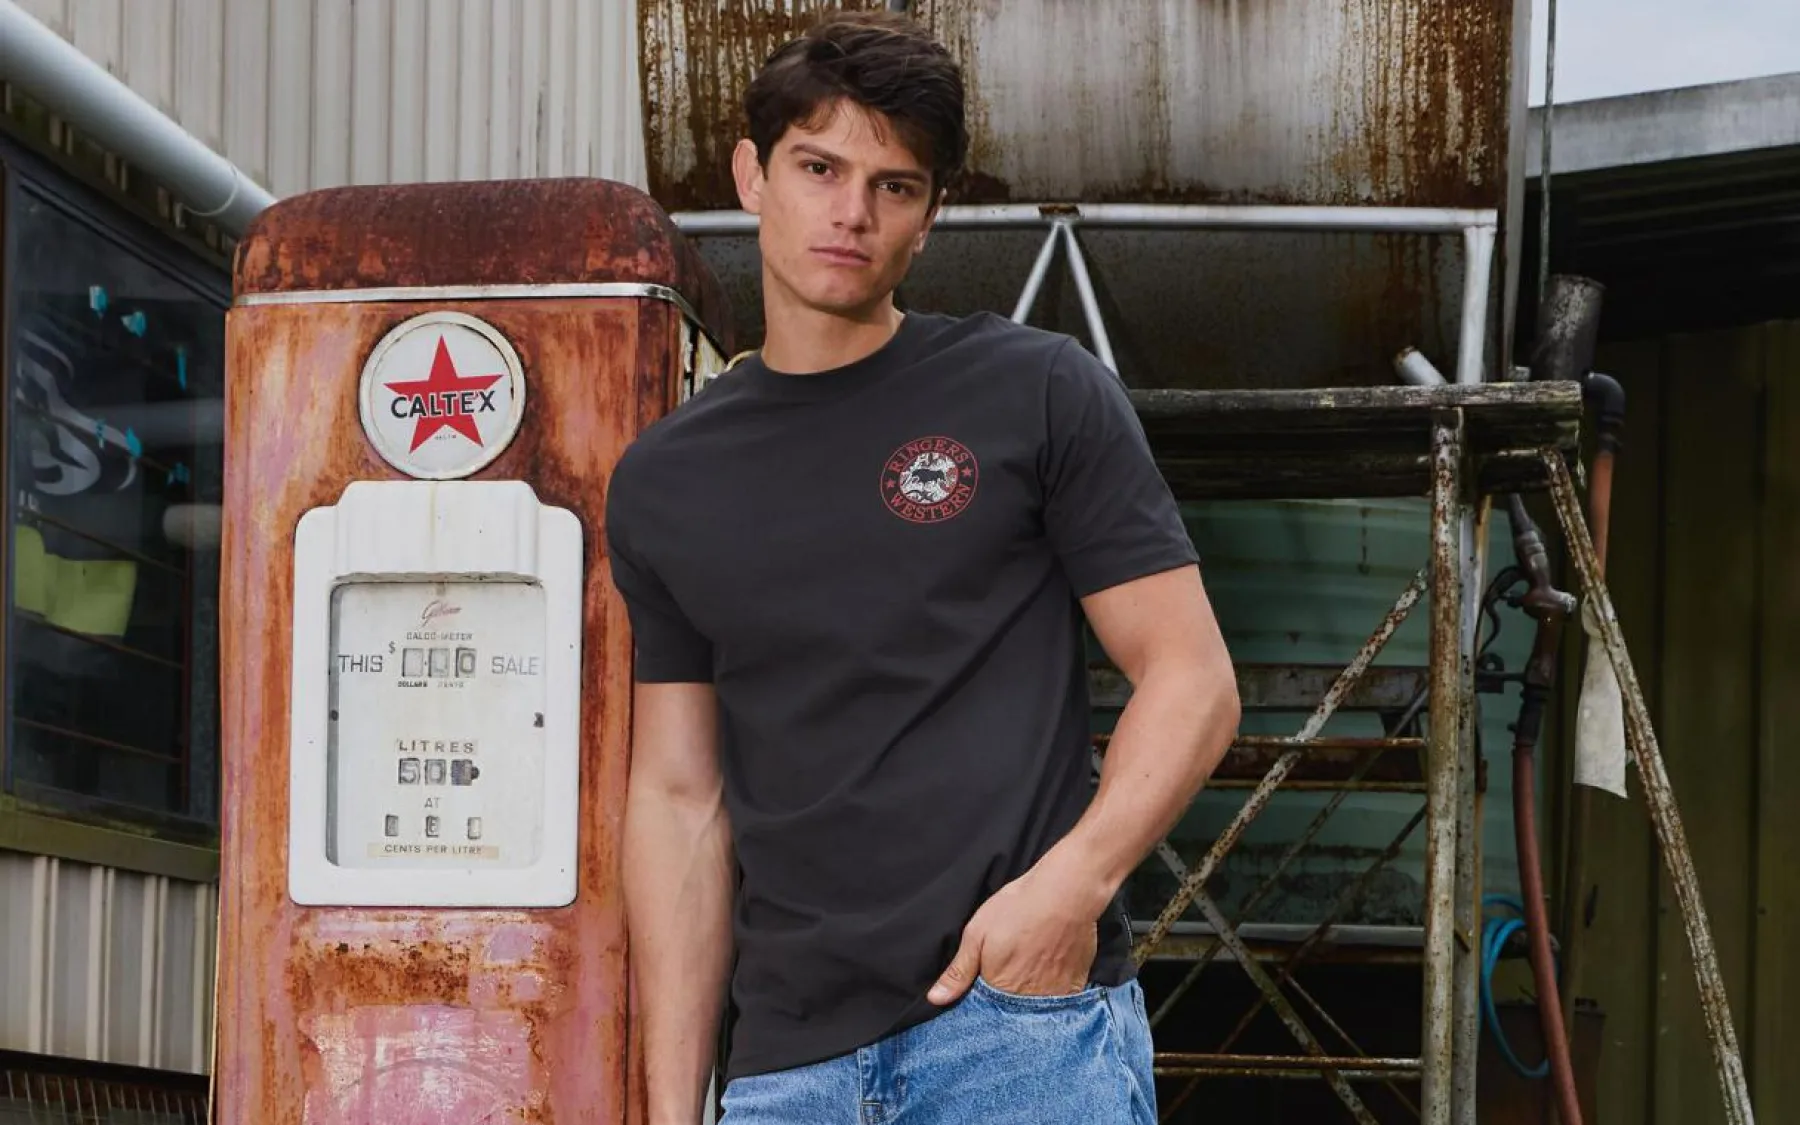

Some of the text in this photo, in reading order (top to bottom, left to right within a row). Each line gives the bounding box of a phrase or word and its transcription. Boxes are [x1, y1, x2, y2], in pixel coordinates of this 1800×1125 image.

[391, 390, 496, 418] CALTEX
[888, 439, 969, 473] RINGERS
[890, 483, 971, 519] WESTERN
[338, 654, 383, 673] THIS
[491, 656, 540, 676] SALE
[399, 740, 474, 754] LITRES
[424, 797, 441, 809] AT
[384, 844, 481, 855] CENTS PER LITRE
